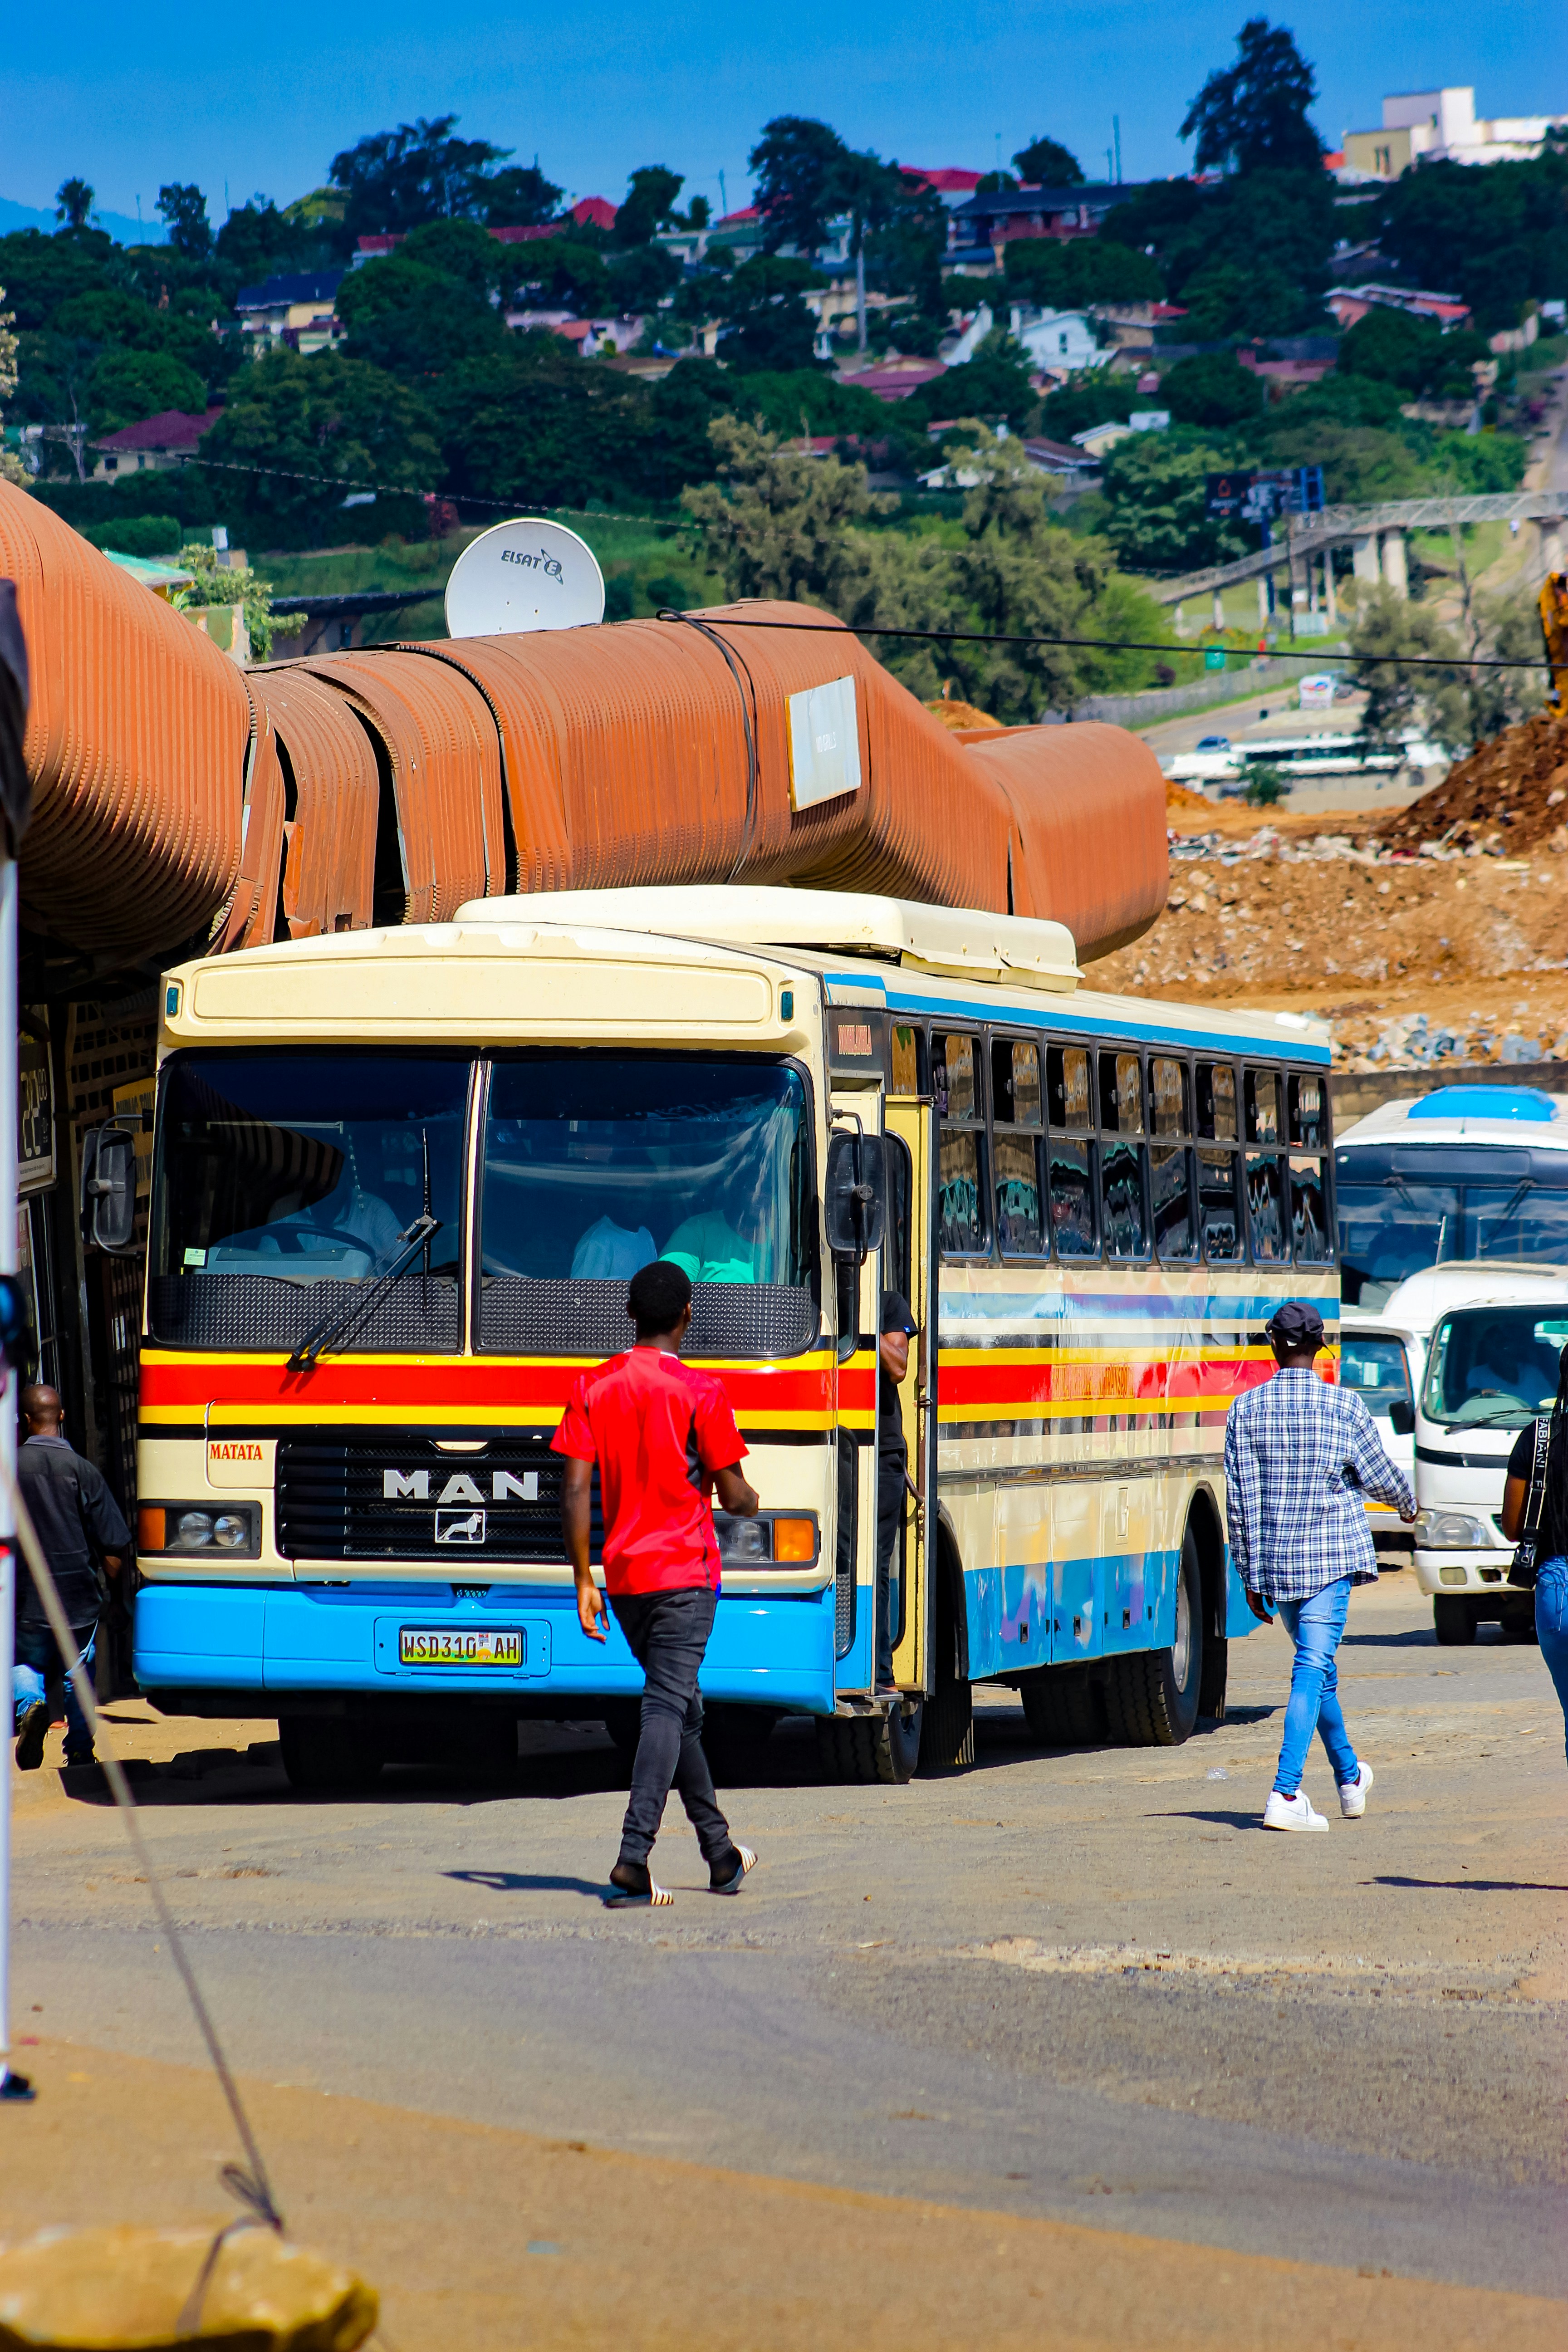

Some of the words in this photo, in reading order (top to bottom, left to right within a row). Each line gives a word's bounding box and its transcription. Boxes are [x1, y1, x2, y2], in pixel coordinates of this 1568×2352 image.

[501, 550, 542, 569] ELSAT
[210, 1444, 263, 1460] MATATA
[1536, 1418, 1548, 1468] FABIANI
[383, 1470, 538, 1503] MAN
[404, 1636, 476, 1658] WSD310
[494, 1637, 516, 1659] AH
